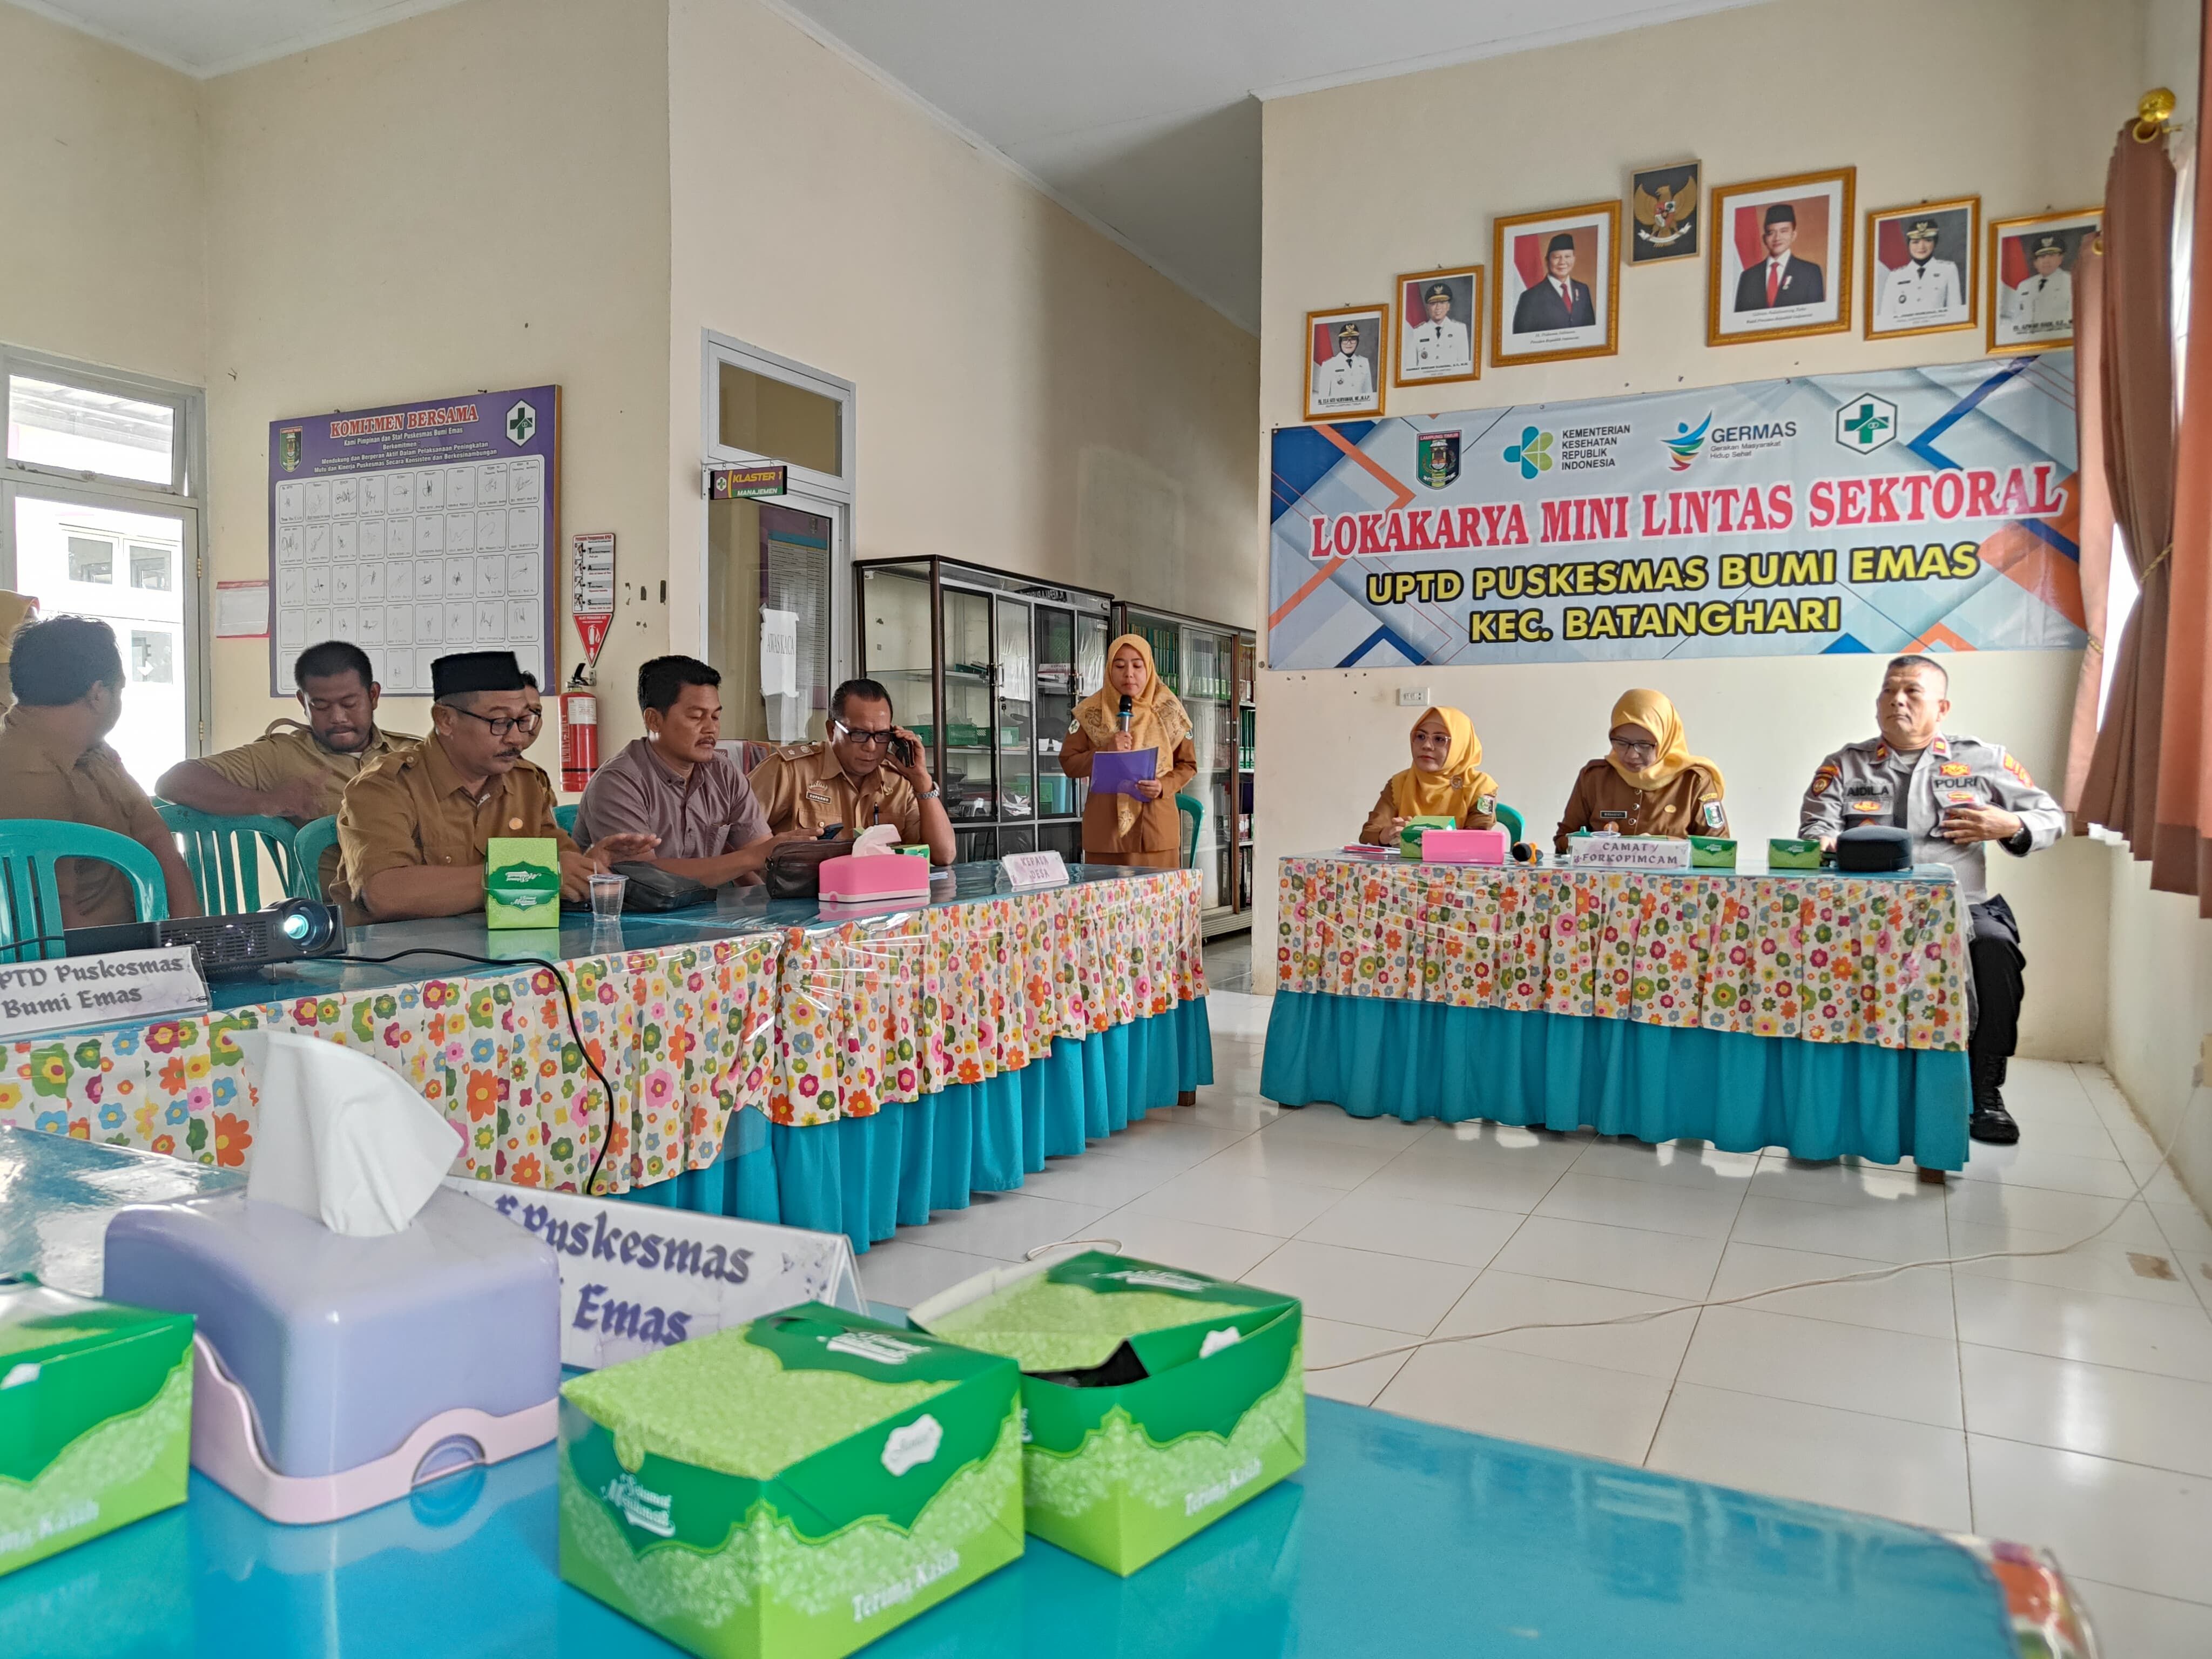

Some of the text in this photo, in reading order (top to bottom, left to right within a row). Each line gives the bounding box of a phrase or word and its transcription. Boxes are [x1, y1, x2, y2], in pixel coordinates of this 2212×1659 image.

[331, 404, 478, 437] KOMITMEN BERSAMA
[1562, 424, 1630, 439] KEMENTERIAN
[1711, 421, 1797, 443] GERMAS
[358, 437, 380, 446] Pimpinan
[404, 431, 433, 439] Puskesmas
[1562, 436, 1617, 449] KESEHATAN
[383, 442, 417, 450] Berkomitmen
[1741, 441, 1782, 449] Masyarakat
[322, 457, 349, 465] Mendukung
[361, 453, 385, 461] Berperan
[417, 446, 452, 454] Pelaksanaan
[454, 442, 488, 451] Peningkatan
[444, 449, 497, 459] Berkesinambungan
[1562, 448, 1607, 460] REPUBLIK
[1561, 458, 1615, 470] INDONESIA
[733, 471, 783, 483] KLASTER 1
[737, 488, 778, 496] MANAJEMEN
[1312, 466, 2061, 557] LOKAKARYA MINI LINTAS SEKTORAL
[1368, 541, 1980, 605] UPTD PUSKESMAS BUMI EMAS
[1469, 597, 1840, 643] KEC. BATANGHARI
[1934, 776, 1979, 788] POLRI
[1602, 842, 1648, 852] CAMAT
[1020, 855, 1049, 866] KEPALA
[1582, 853, 1678, 864] FORKOPIMCAM
[1030, 868, 1050, 879] DESA
[54, 958, 184, 983] Puskesmas
[1, 988, 143, 1019] Bumi Emas
[572, 1283, 693, 1346] Emas
